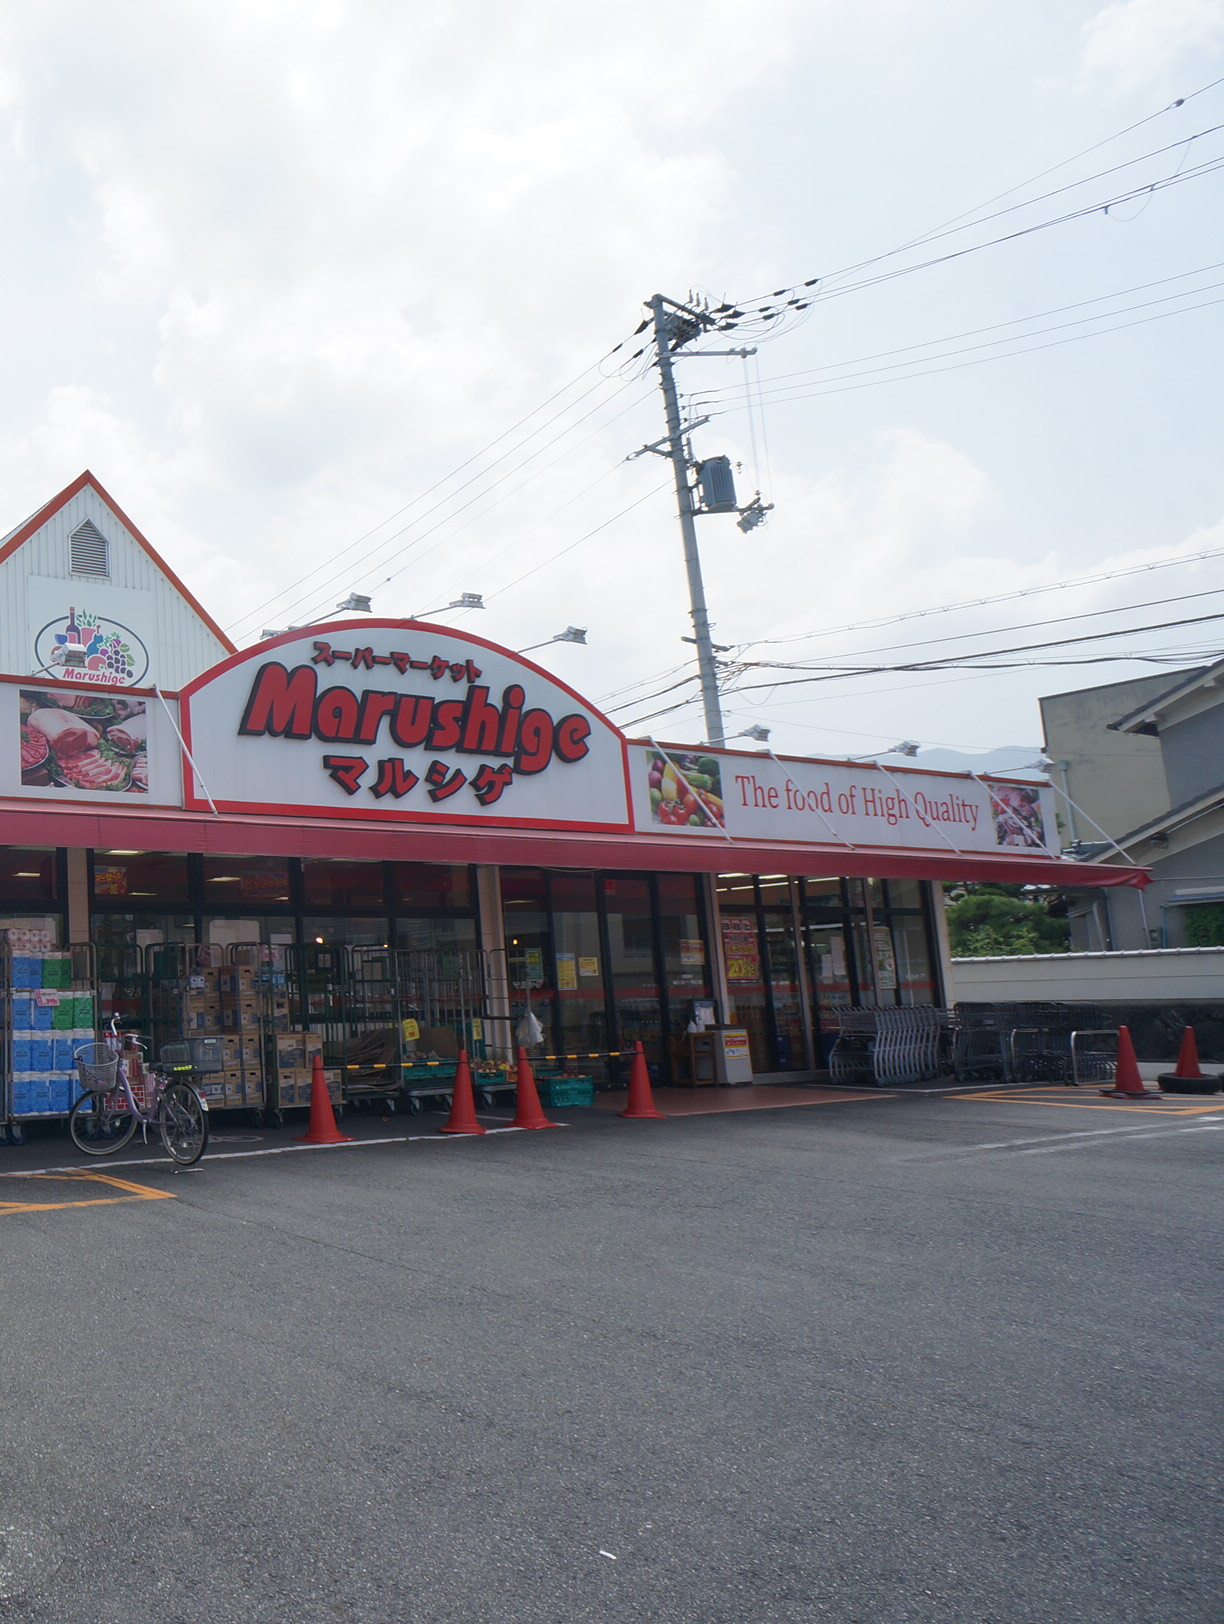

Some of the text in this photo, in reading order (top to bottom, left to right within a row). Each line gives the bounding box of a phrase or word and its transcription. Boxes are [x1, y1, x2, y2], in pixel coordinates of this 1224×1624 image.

[63, 668, 126, 685] Marushige
[312, 641, 483, 684] スーパーマーケット
[238, 661, 592, 776] Marushige
[323, 754, 513, 806] マルシゲ
[734, 774, 979, 831] The food of High Quality
